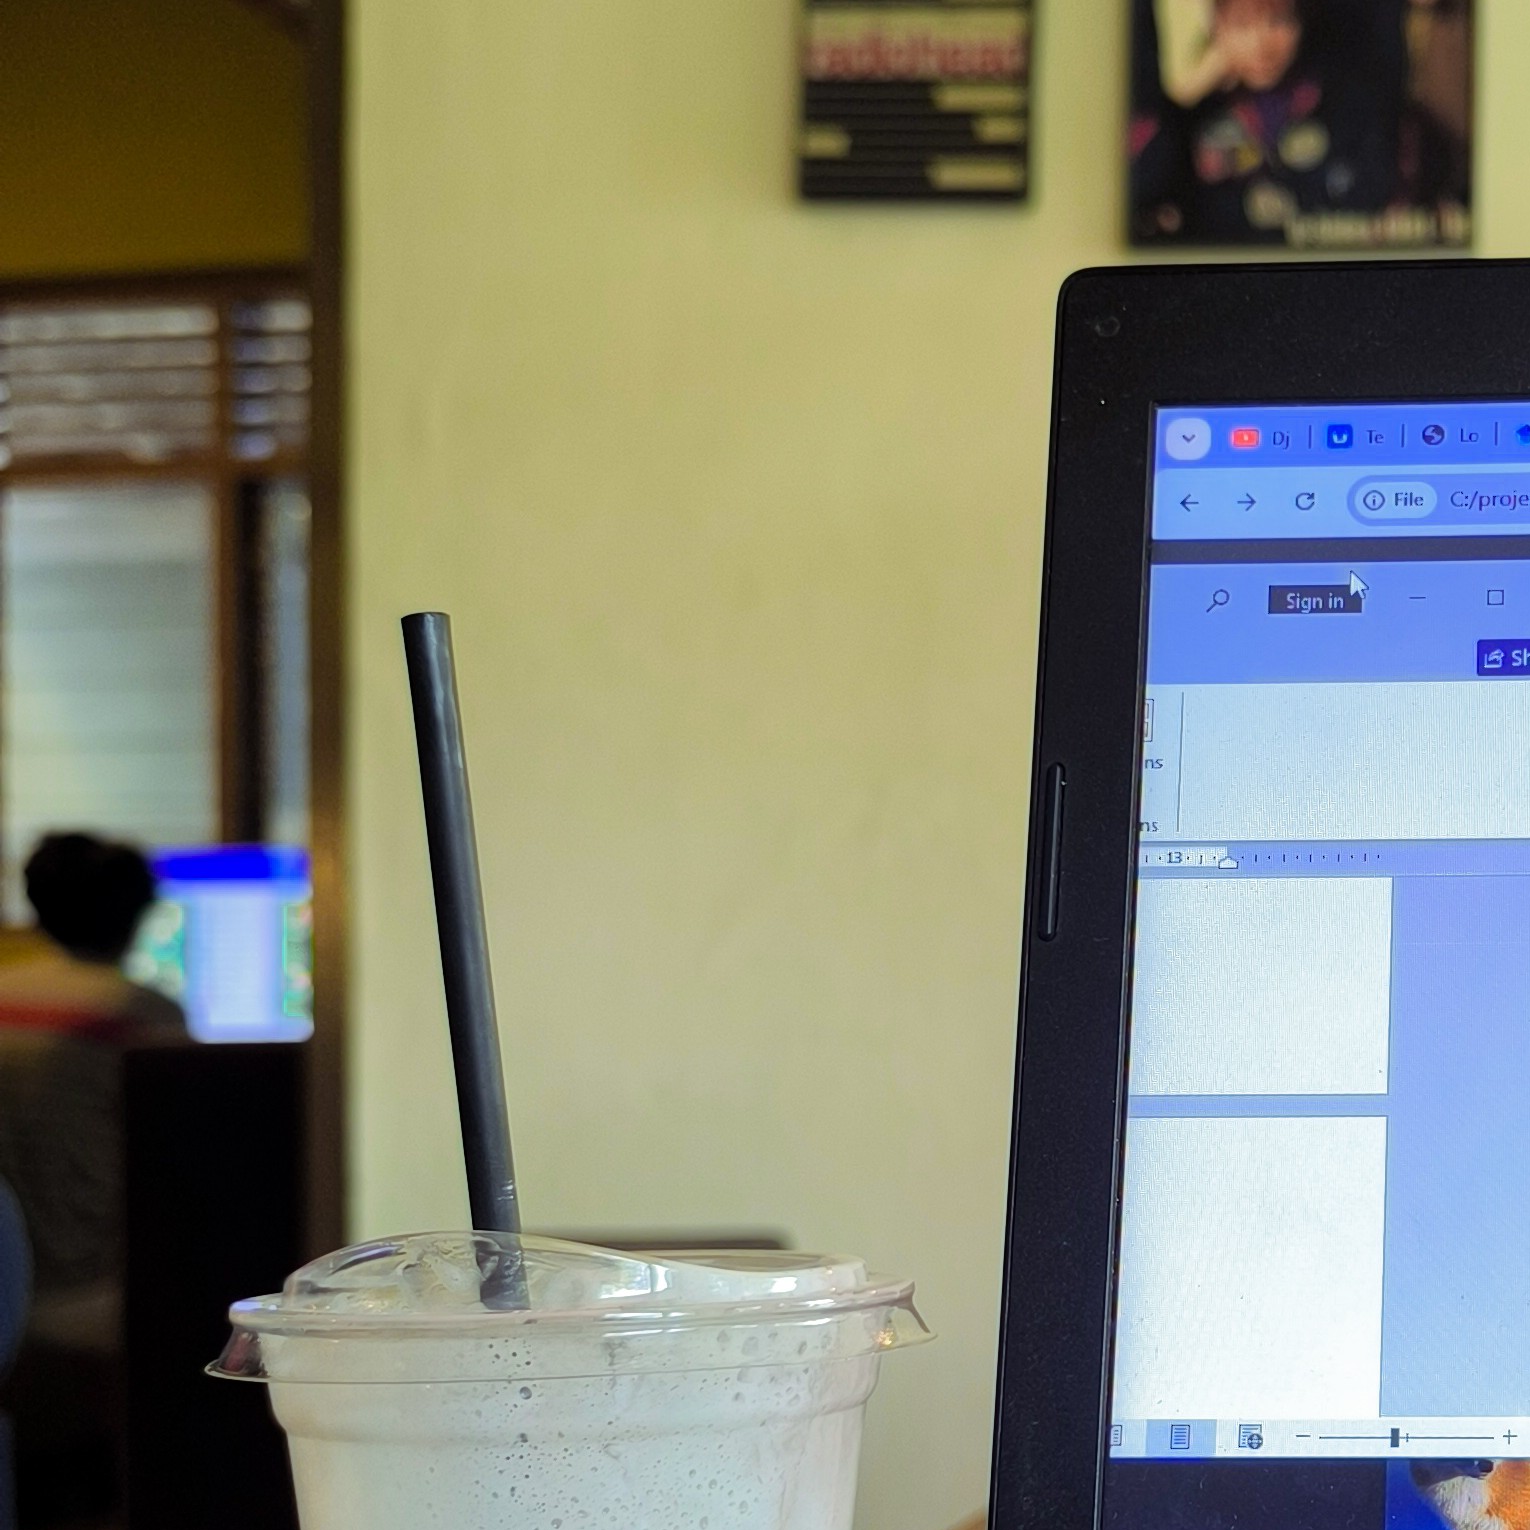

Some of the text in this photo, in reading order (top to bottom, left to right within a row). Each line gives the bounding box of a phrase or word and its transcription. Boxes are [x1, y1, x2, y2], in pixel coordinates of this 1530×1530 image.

[1367, 429, 1385, 445] Te
[1393, 491, 1424, 508] File
[1286, 592, 1344, 613] Sign in
[1166, 851, 1183, 864] 13
